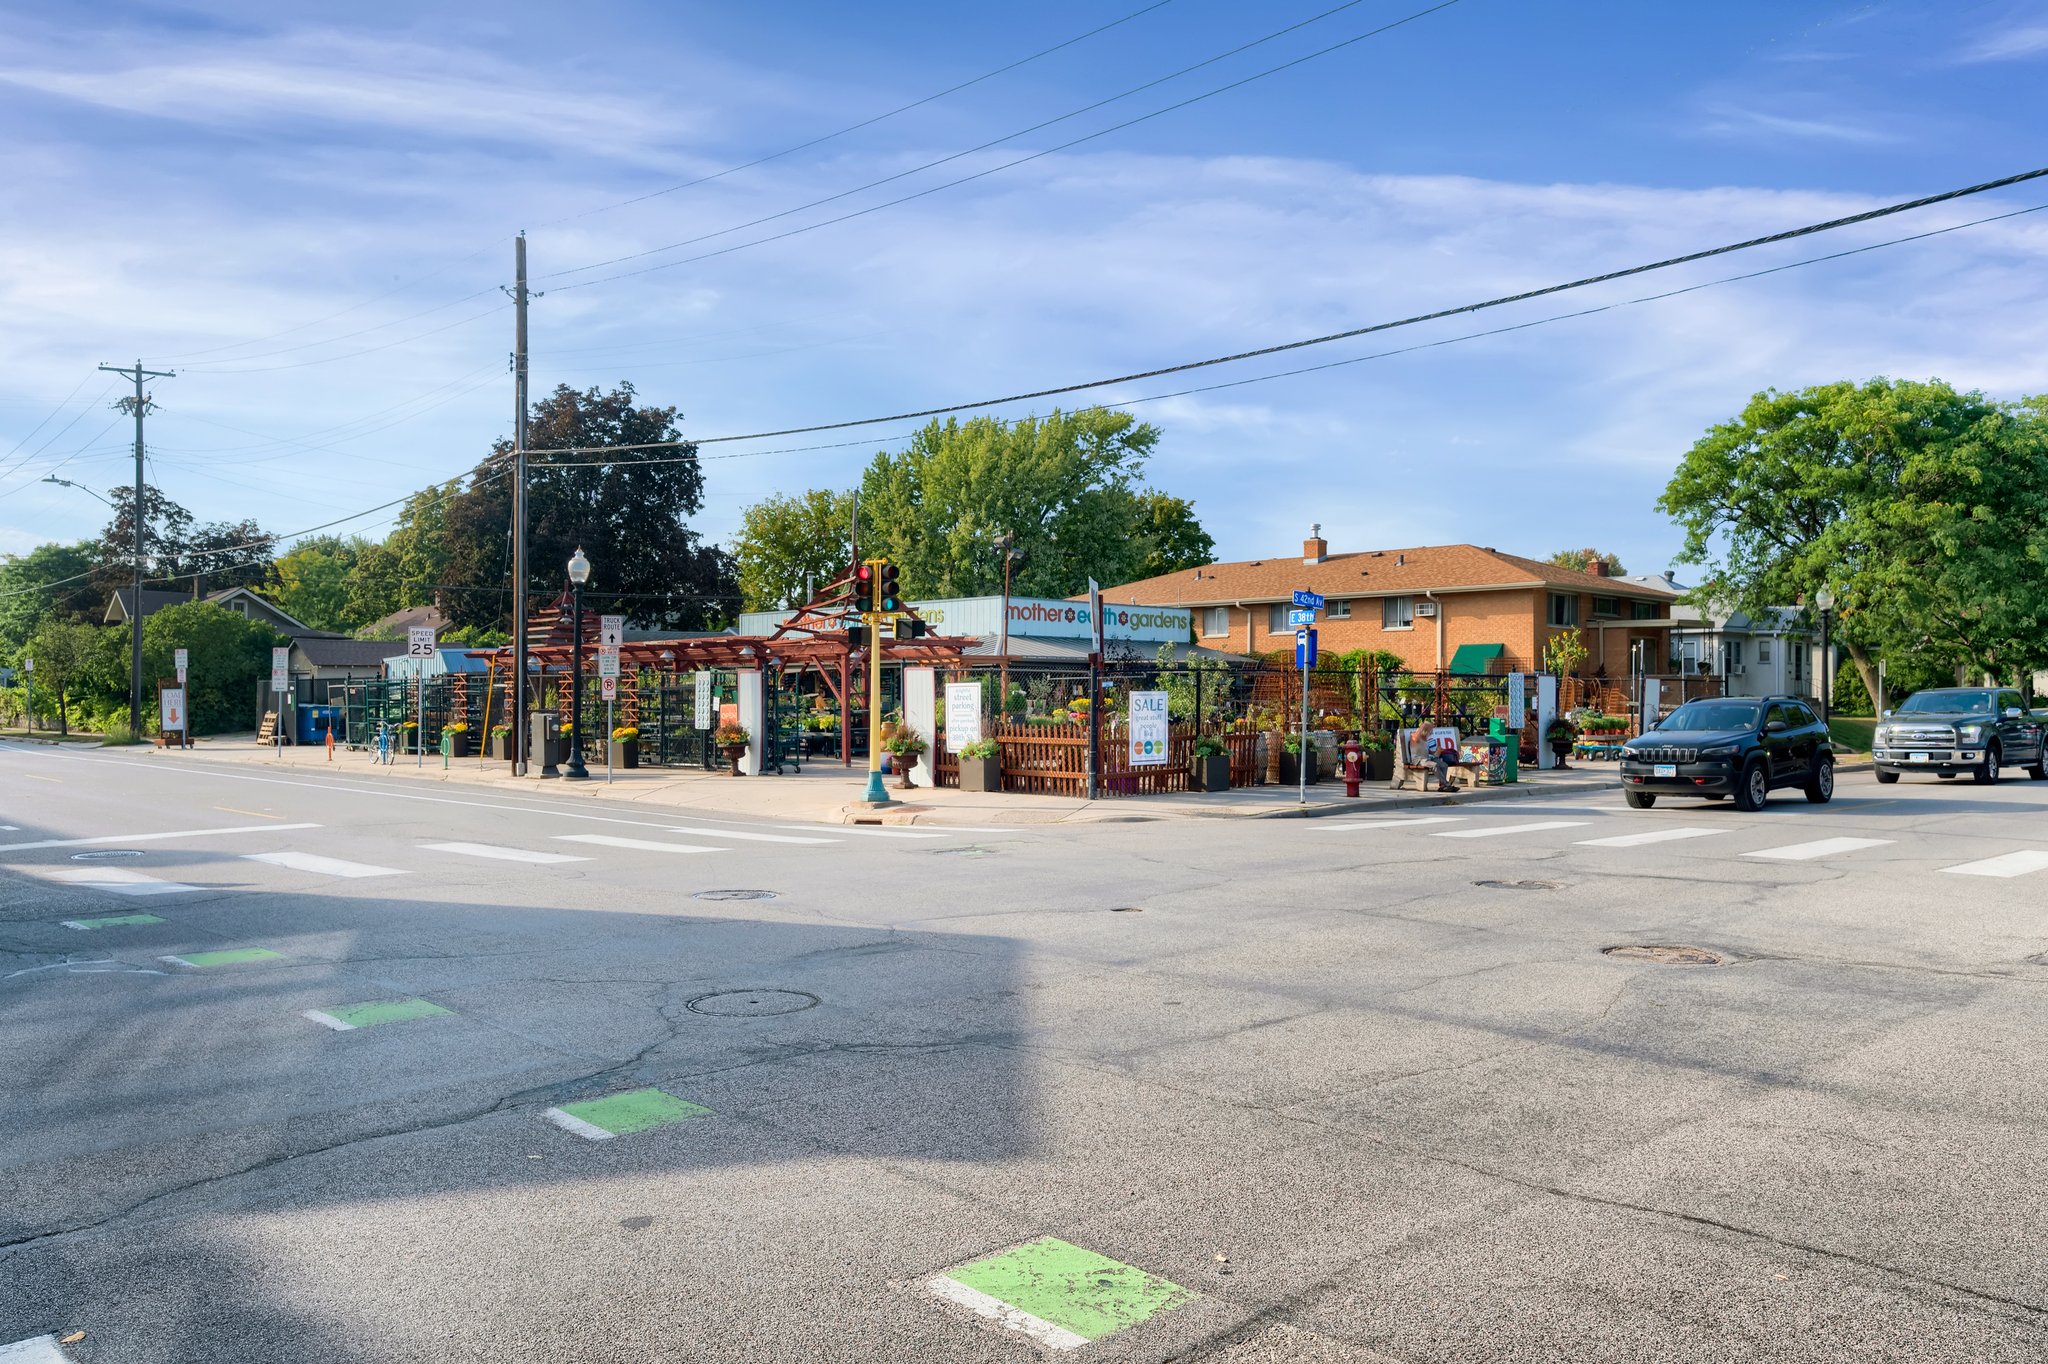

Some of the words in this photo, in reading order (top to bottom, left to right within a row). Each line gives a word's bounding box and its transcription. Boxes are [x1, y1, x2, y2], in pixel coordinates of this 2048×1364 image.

[1294, 593, 1298, 602] S
[1300, 594, 1315, 605] 42nd
[1316, 597, 1323, 606] Av
[1007, 603, 1063, 622] mother
[1077, 607, 1117, 625] eth
[1129, 611, 1187, 631] gardens
[1291, 614, 1296, 623] E
[1297, 612, 1315, 622] 38th
[411, 643, 433, 655] 25
[952, 702, 975, 711] parking
[1134, 698, 1164, 711] SALE
